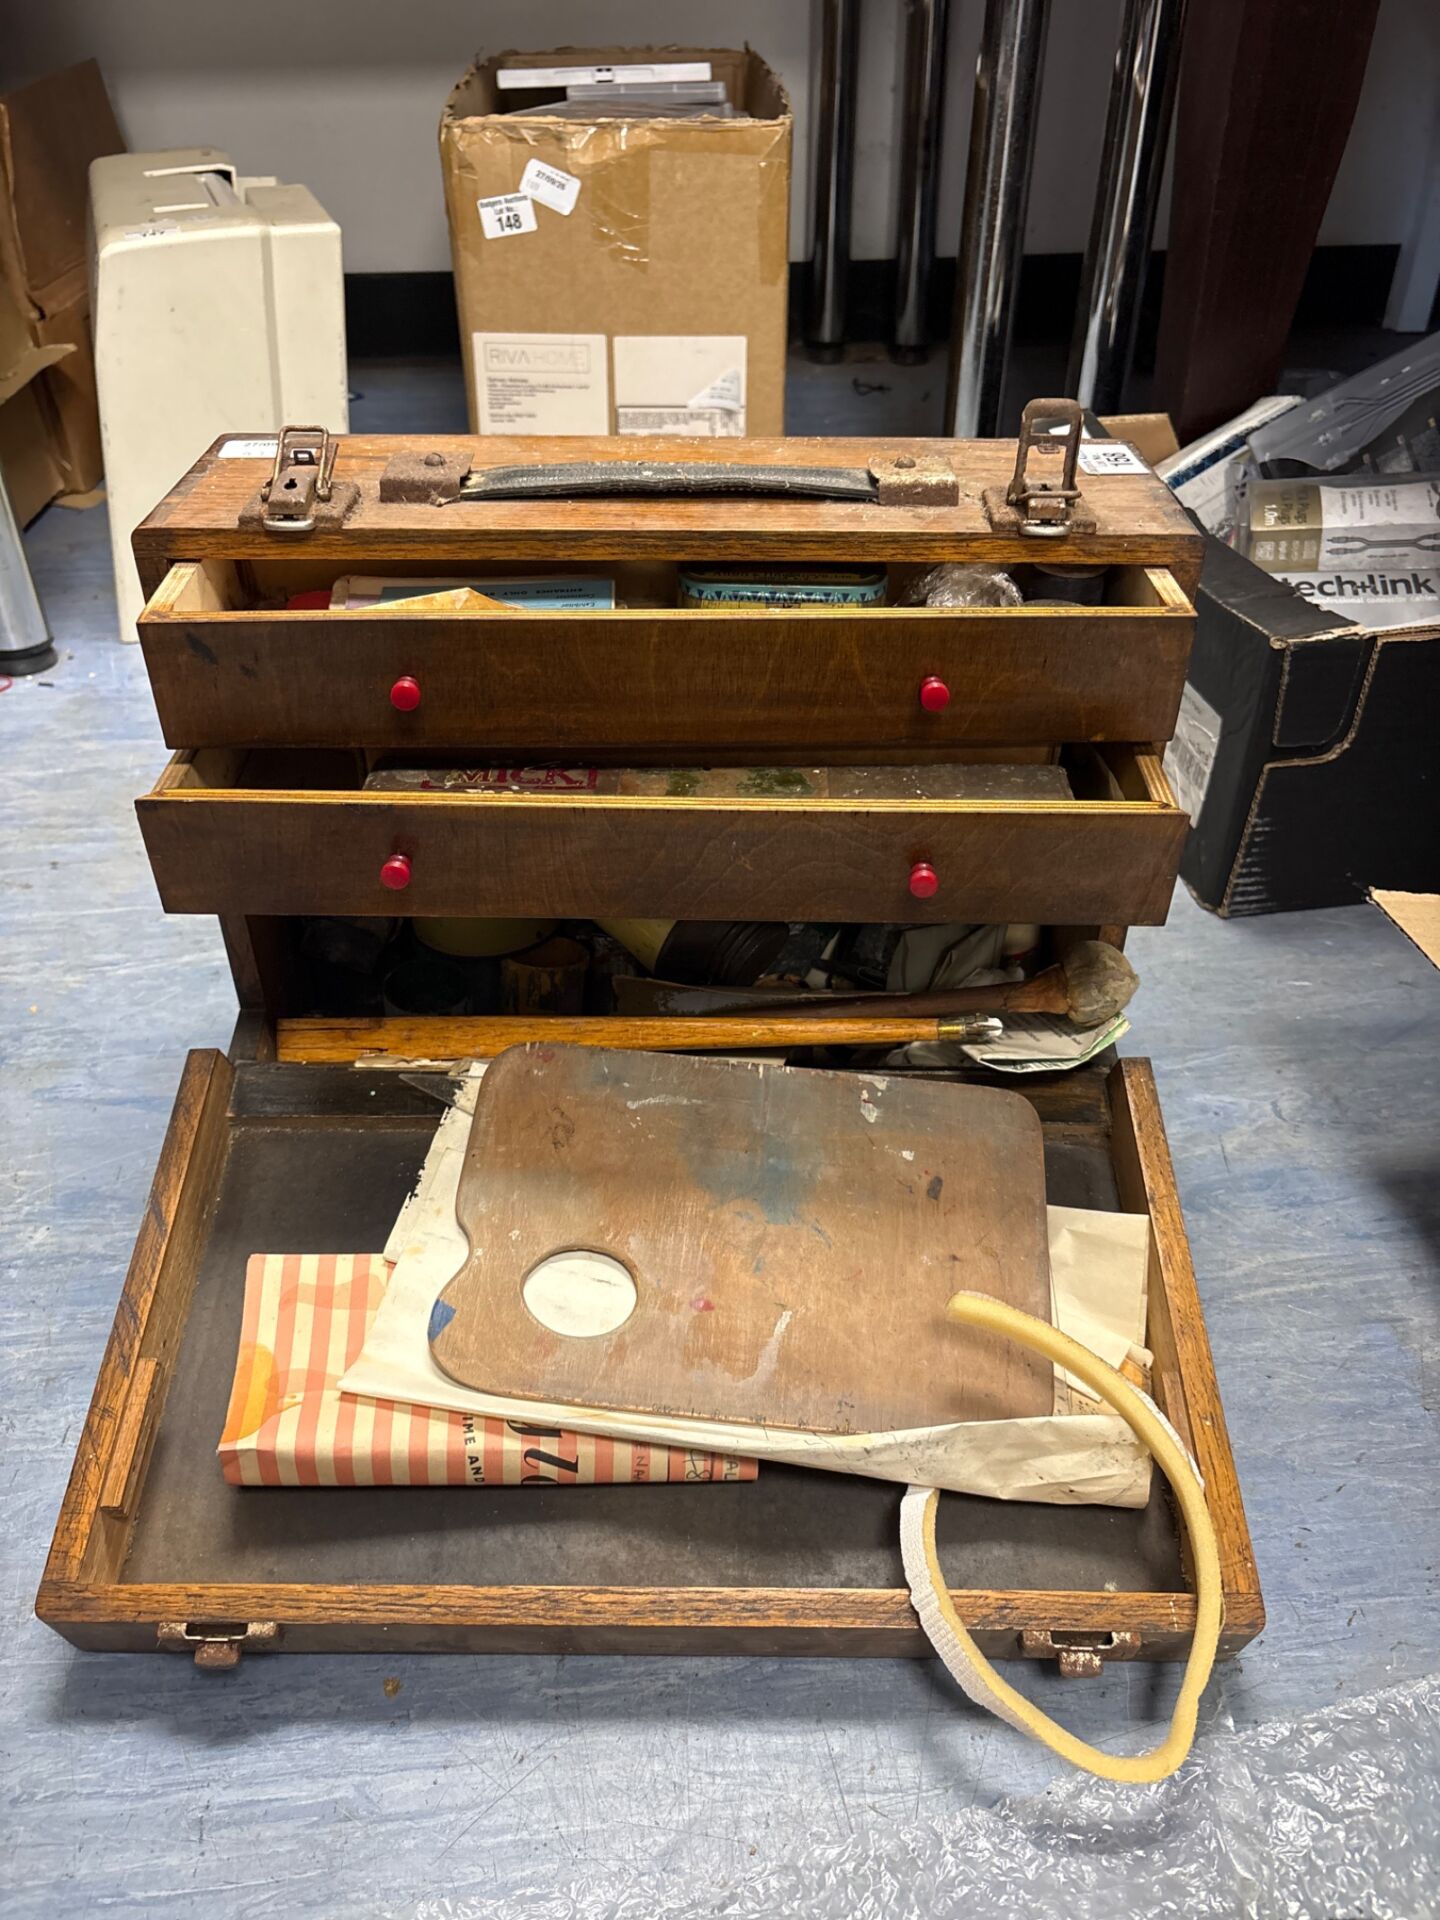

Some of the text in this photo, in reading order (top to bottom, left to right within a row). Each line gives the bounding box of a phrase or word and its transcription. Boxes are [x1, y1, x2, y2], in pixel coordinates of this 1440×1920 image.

[496, 214, 522, 232] 148
[1264, 503, 1275, 527] 1.0m
[462, 1415, 476, 1446] IME
